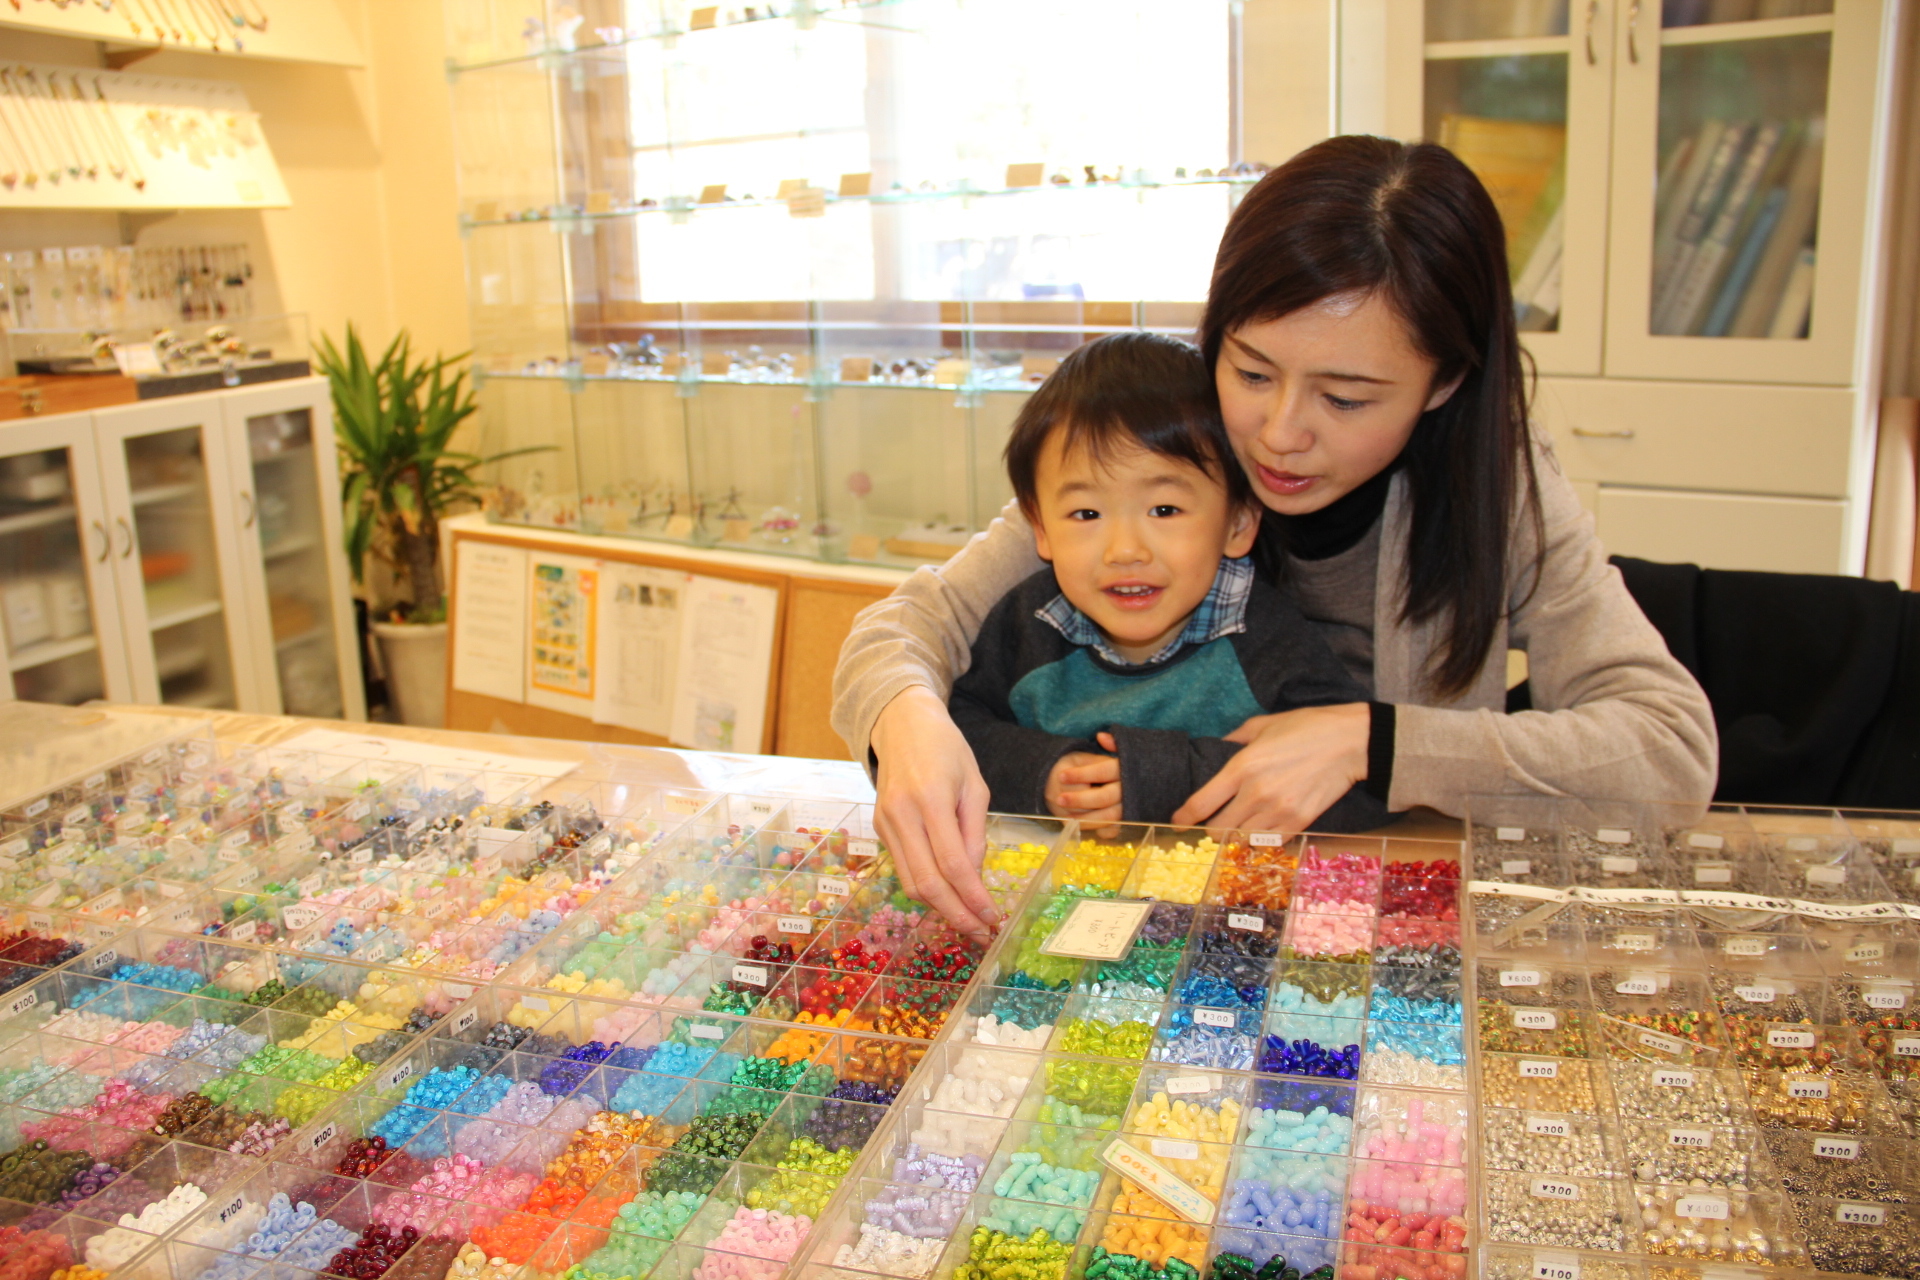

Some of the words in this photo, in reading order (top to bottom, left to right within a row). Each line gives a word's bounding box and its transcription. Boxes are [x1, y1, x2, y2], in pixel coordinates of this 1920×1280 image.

[822, 884, 843, 894] ¥300
[781, 922, 804, 931] ¥300
[1237, 917, 1259, 928] ¥300
[95, 951, 114, 965] ¥100
[1854, 949, 1879, 957] ¥500
[736, 971, 760, 982] ¥300
[1508, 975, 1532, 983] ¥600
[12, 994, 34, 1013] ¥100
[1866, 995, 1900, 1006] ¥1500
[459, 1012, 474, 1028] ¥100
[1202, 1012, 1228, 1023] ¥300
[1521, 1016, 1546, 1024] ¥300
[1644, 1038, 1670, 1050] ¥300
[1773, 1036, 1799, 1044] ¥300
[392, 1065, 410, 1085] ¥100
[1526, 1067, 1553, 1075] ¥300
[1660, 1077, 1687, 1085] ¥300
[1794, 1088, 1822, 1097] ¥300
[1536, 1126, 1563, 1134] ¥300
[313, 1127, 332, 1147] ¥100
[1674, 1136, 1703, 1146] ¥300
[1820, 1146, 1850, 1156] ¥300
[1120, 1155, 1159, 1184] ¥300
[1542, 1184, 1572, 1196] ¥300
[220, 1198, 242, 1222] ¥100
[1686, 1204, 1719, 1214] ¥400
[1843, 1212, 1878, 1223] ¥300
[1540, 1267, 1572, 1280] ¥100
